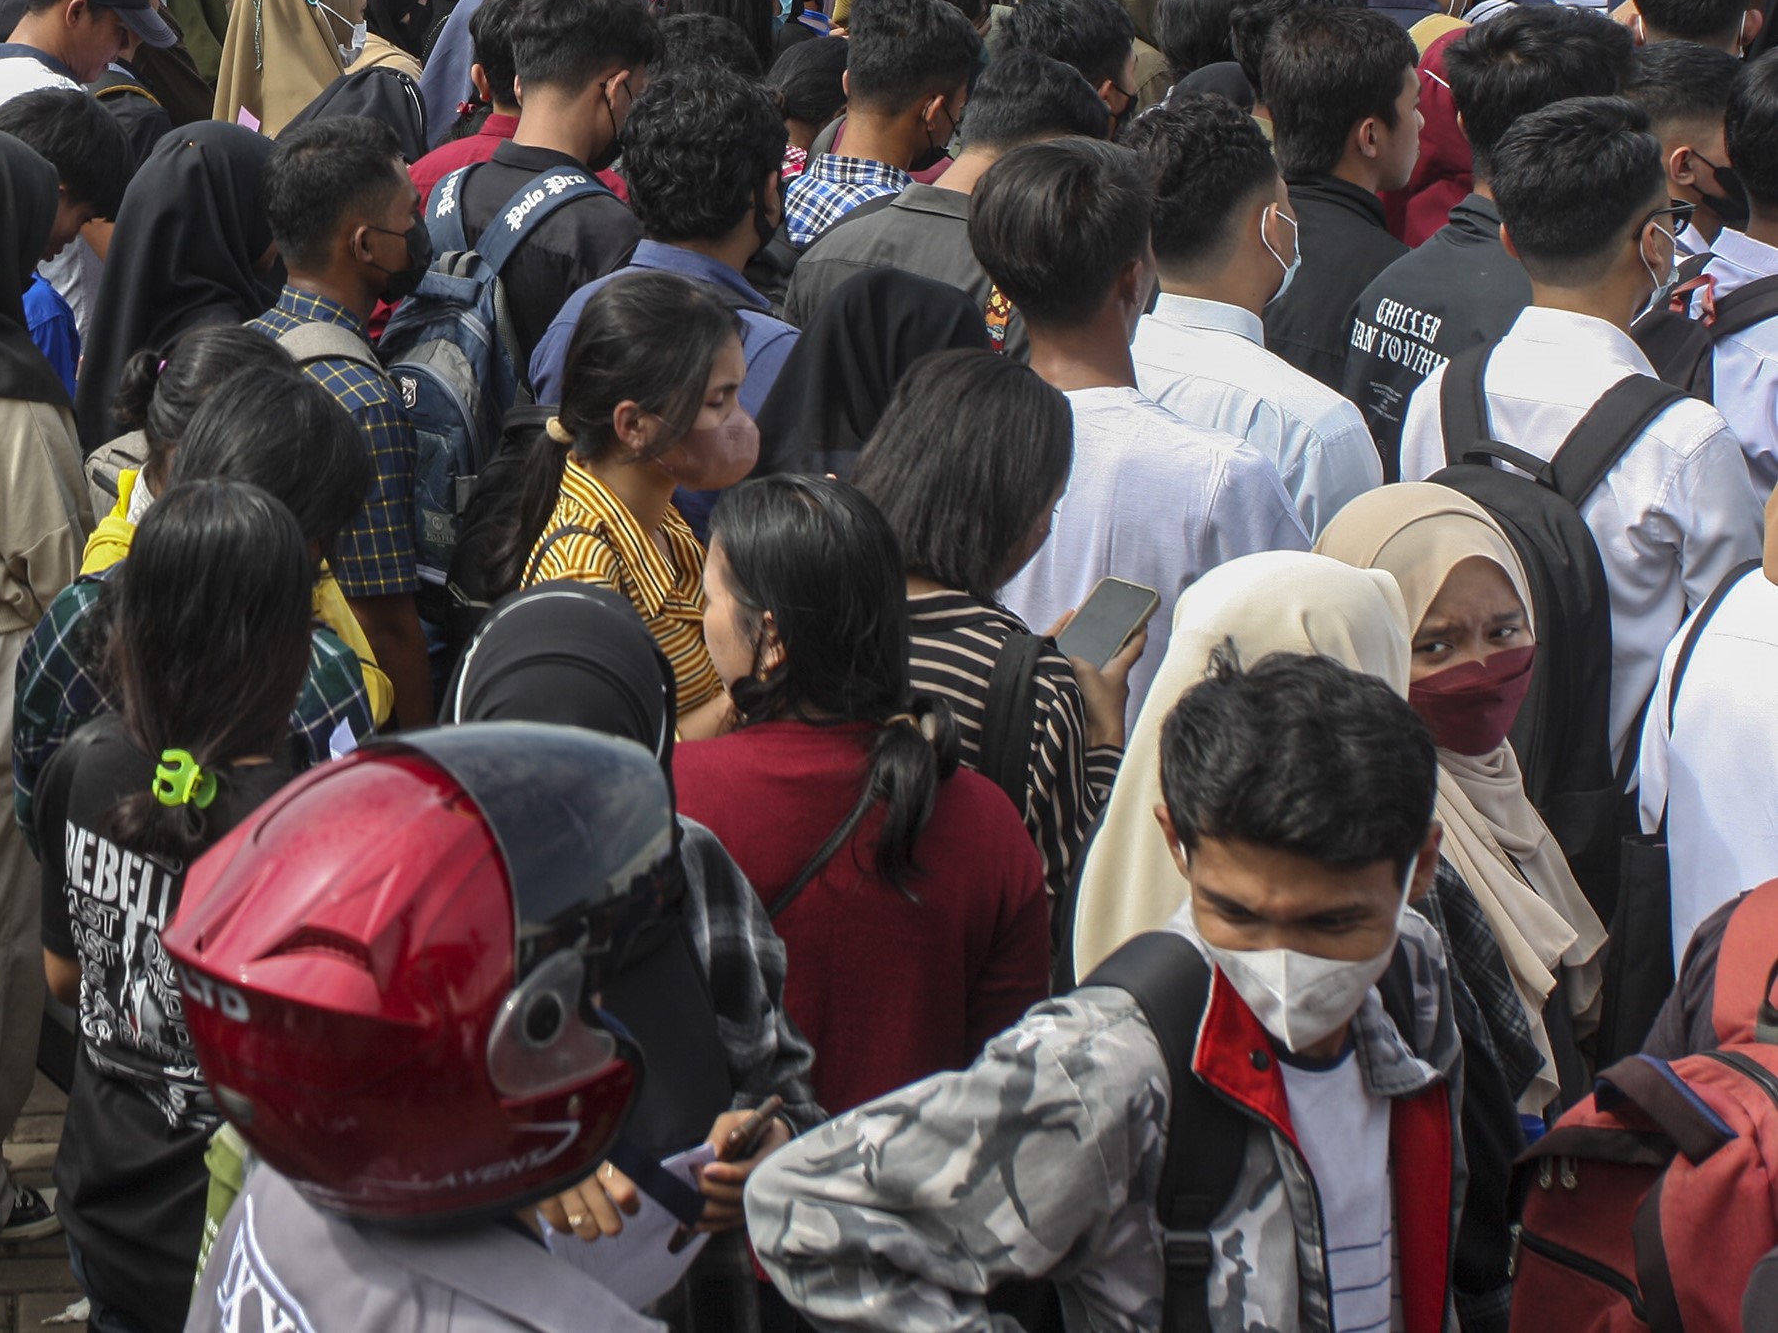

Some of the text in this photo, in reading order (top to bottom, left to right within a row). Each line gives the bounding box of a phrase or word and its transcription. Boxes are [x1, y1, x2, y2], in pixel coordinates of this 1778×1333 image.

[504, 174, 587, 232] Polo Pro
[1375, 297, 1442, 345] CHILLER
[178, 962, 250, 1023] LTD
